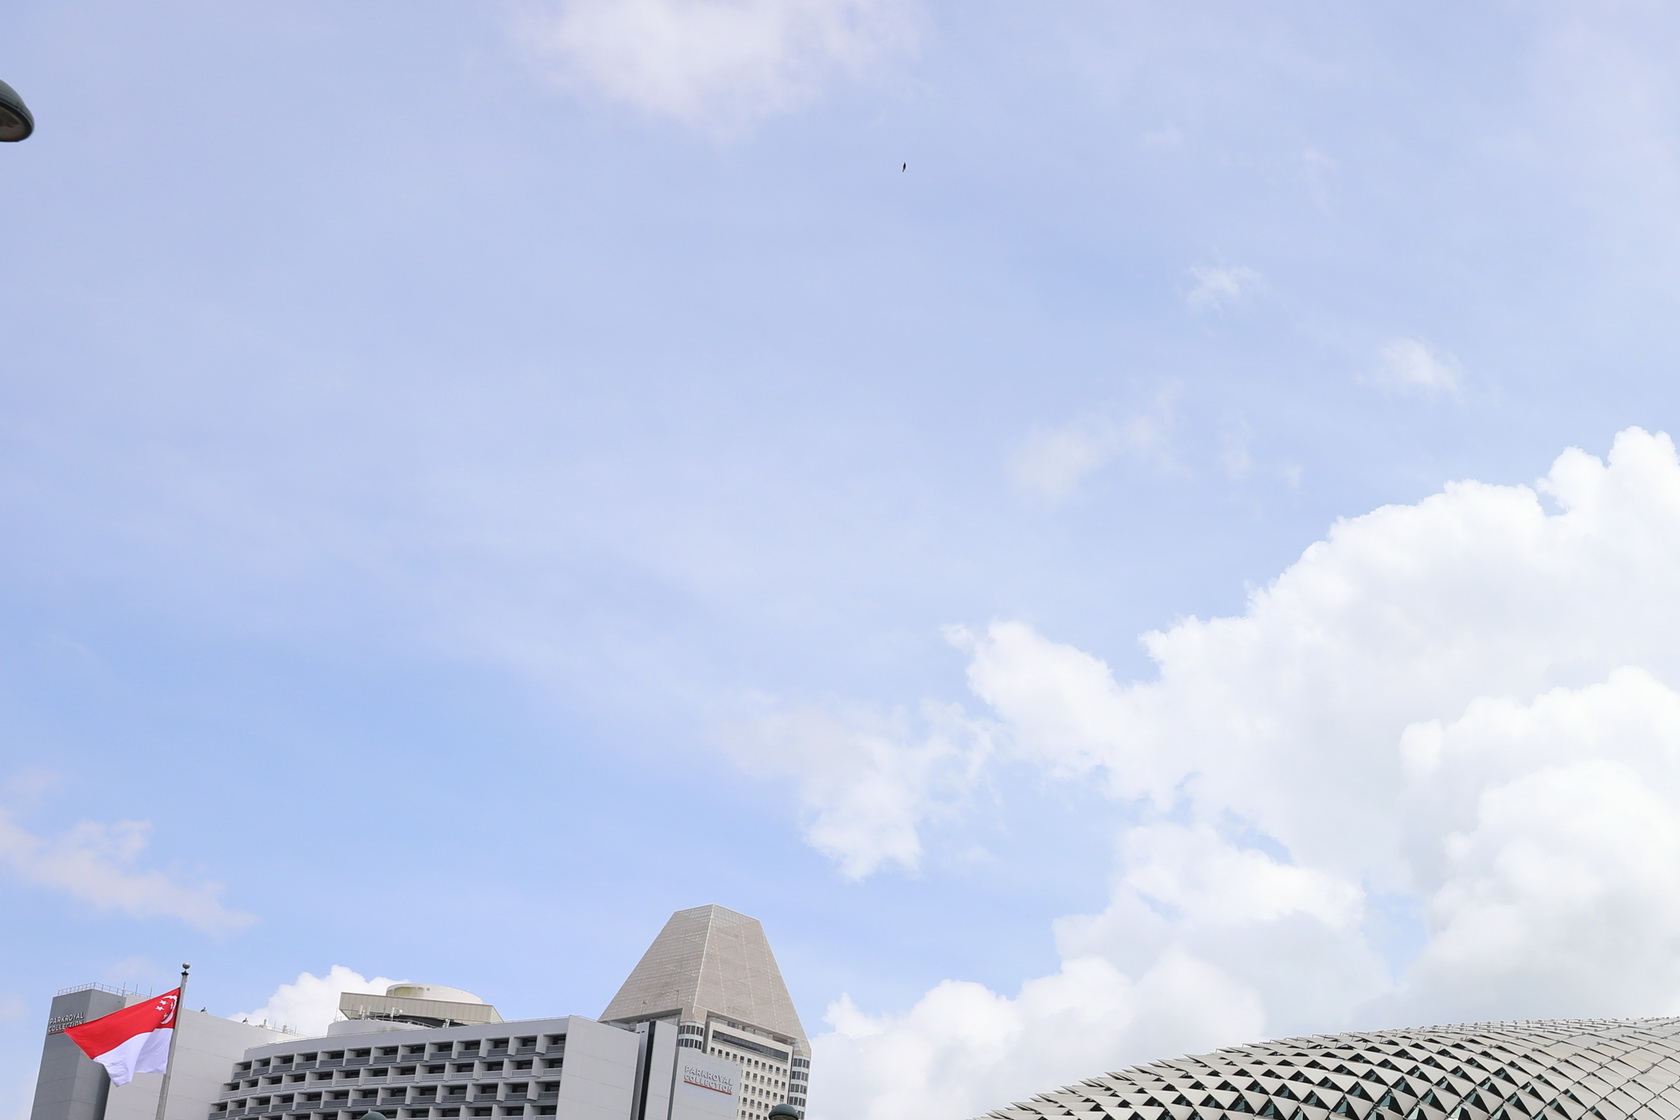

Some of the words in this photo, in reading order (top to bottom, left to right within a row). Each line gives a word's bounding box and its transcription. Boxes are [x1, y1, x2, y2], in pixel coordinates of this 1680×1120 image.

[50, 1012, 84, 1025] PARKROYAL
[683, 1074, 733, 1093] COLLECTION
[684, 1065, 733, 1086] PARKROYAL
